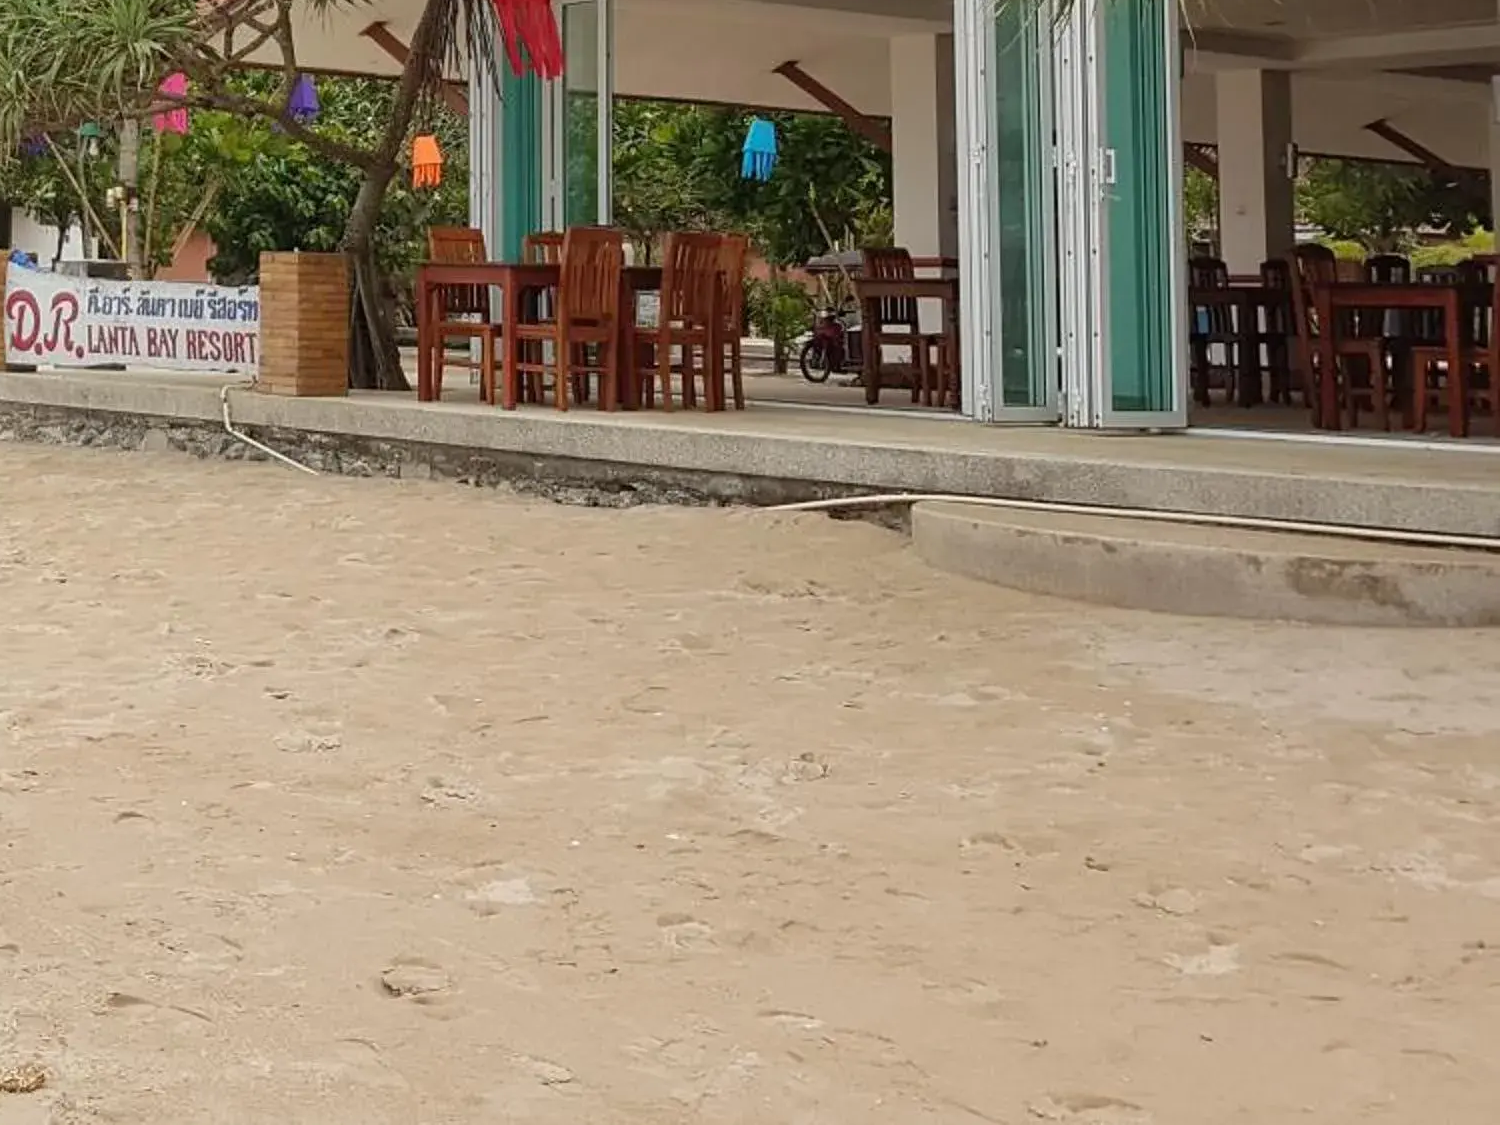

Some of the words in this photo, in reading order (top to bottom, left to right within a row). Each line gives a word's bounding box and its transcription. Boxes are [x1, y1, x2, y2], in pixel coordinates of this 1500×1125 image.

[87, 324, 140, 356] LANTA
[147, 327, 179, 359] BAY
[186, 328, 257, 363] RESORT
